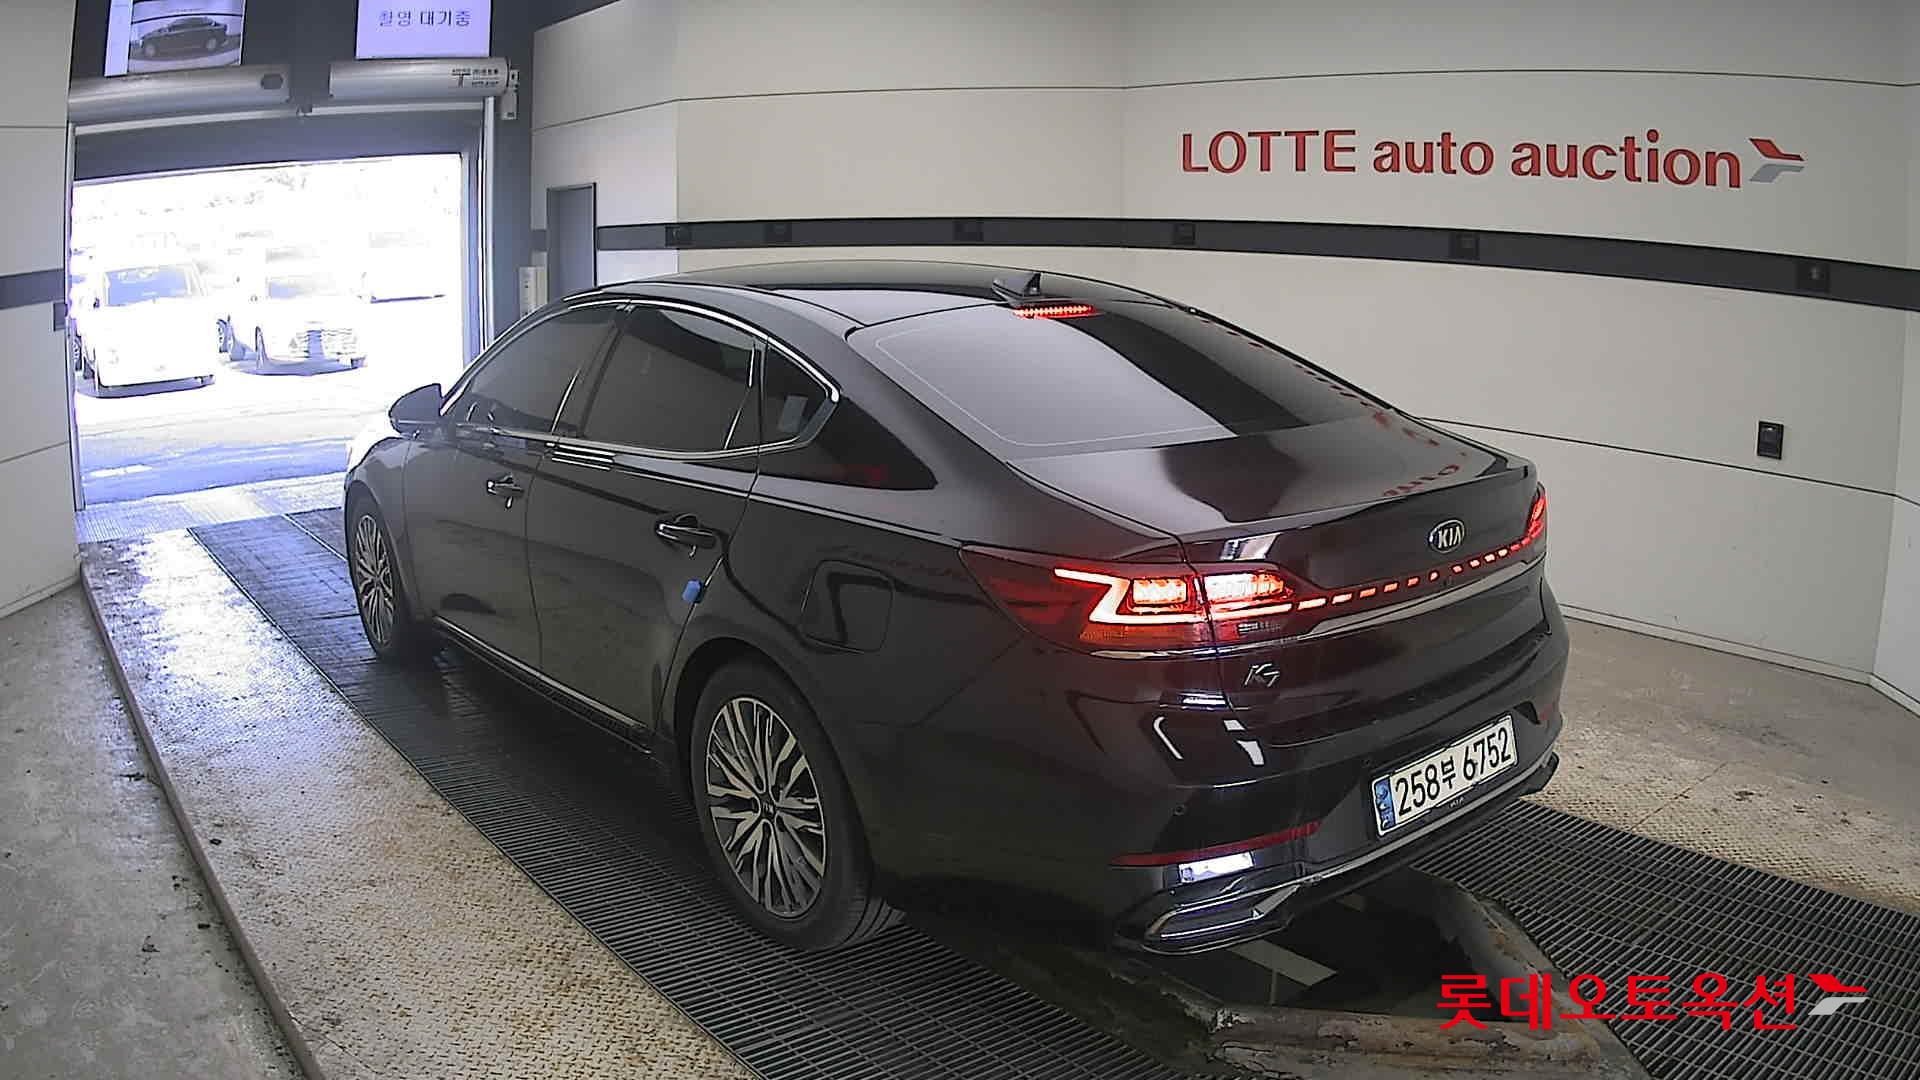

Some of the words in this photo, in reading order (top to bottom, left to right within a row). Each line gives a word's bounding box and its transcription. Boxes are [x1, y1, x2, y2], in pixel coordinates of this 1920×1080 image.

[420, 10, 470, 26] 대기중
[1182, 129, 1356, 173] LOTTE
[1373, 132, 1494, 176] auto
[1511, 129, 1741, 188] auction
[1438, 526, 1461, 548] KIA
[1244, 663, 1280, 687] K7
[1395, 756, 1456, 816] 258부
[1463, 727, 1512, 781] 6752
